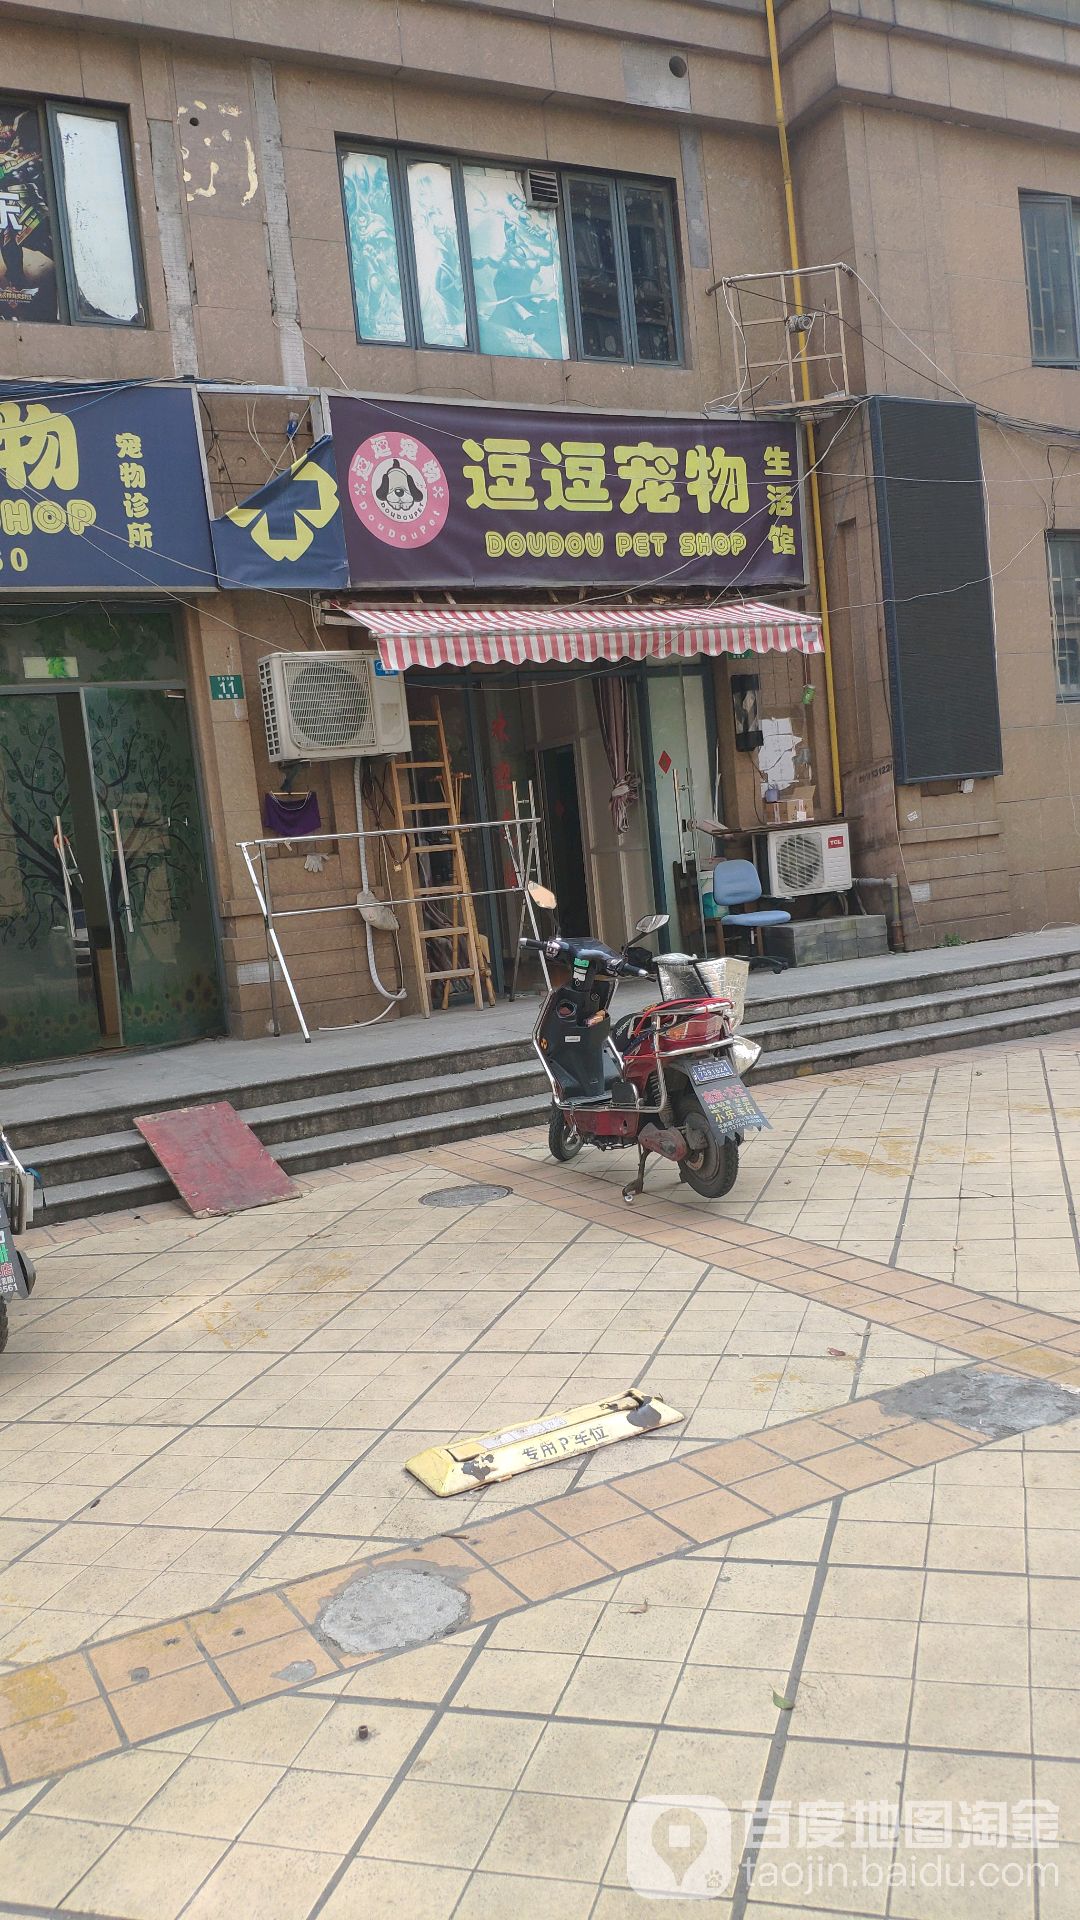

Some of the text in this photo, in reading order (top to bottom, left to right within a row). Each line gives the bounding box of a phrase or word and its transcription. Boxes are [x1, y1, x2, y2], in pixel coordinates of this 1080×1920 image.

[115, 432, 153, 549] 宠物诊所
[462, 437, 750, 514] 逗逗宠物
[763, 445, 796, 556] 生活馆
[0, 498, 96, 536] HOP
[485, 531, 747, 557] DOUDOU PET SHOP
[219, 681, 235, 694] 11
